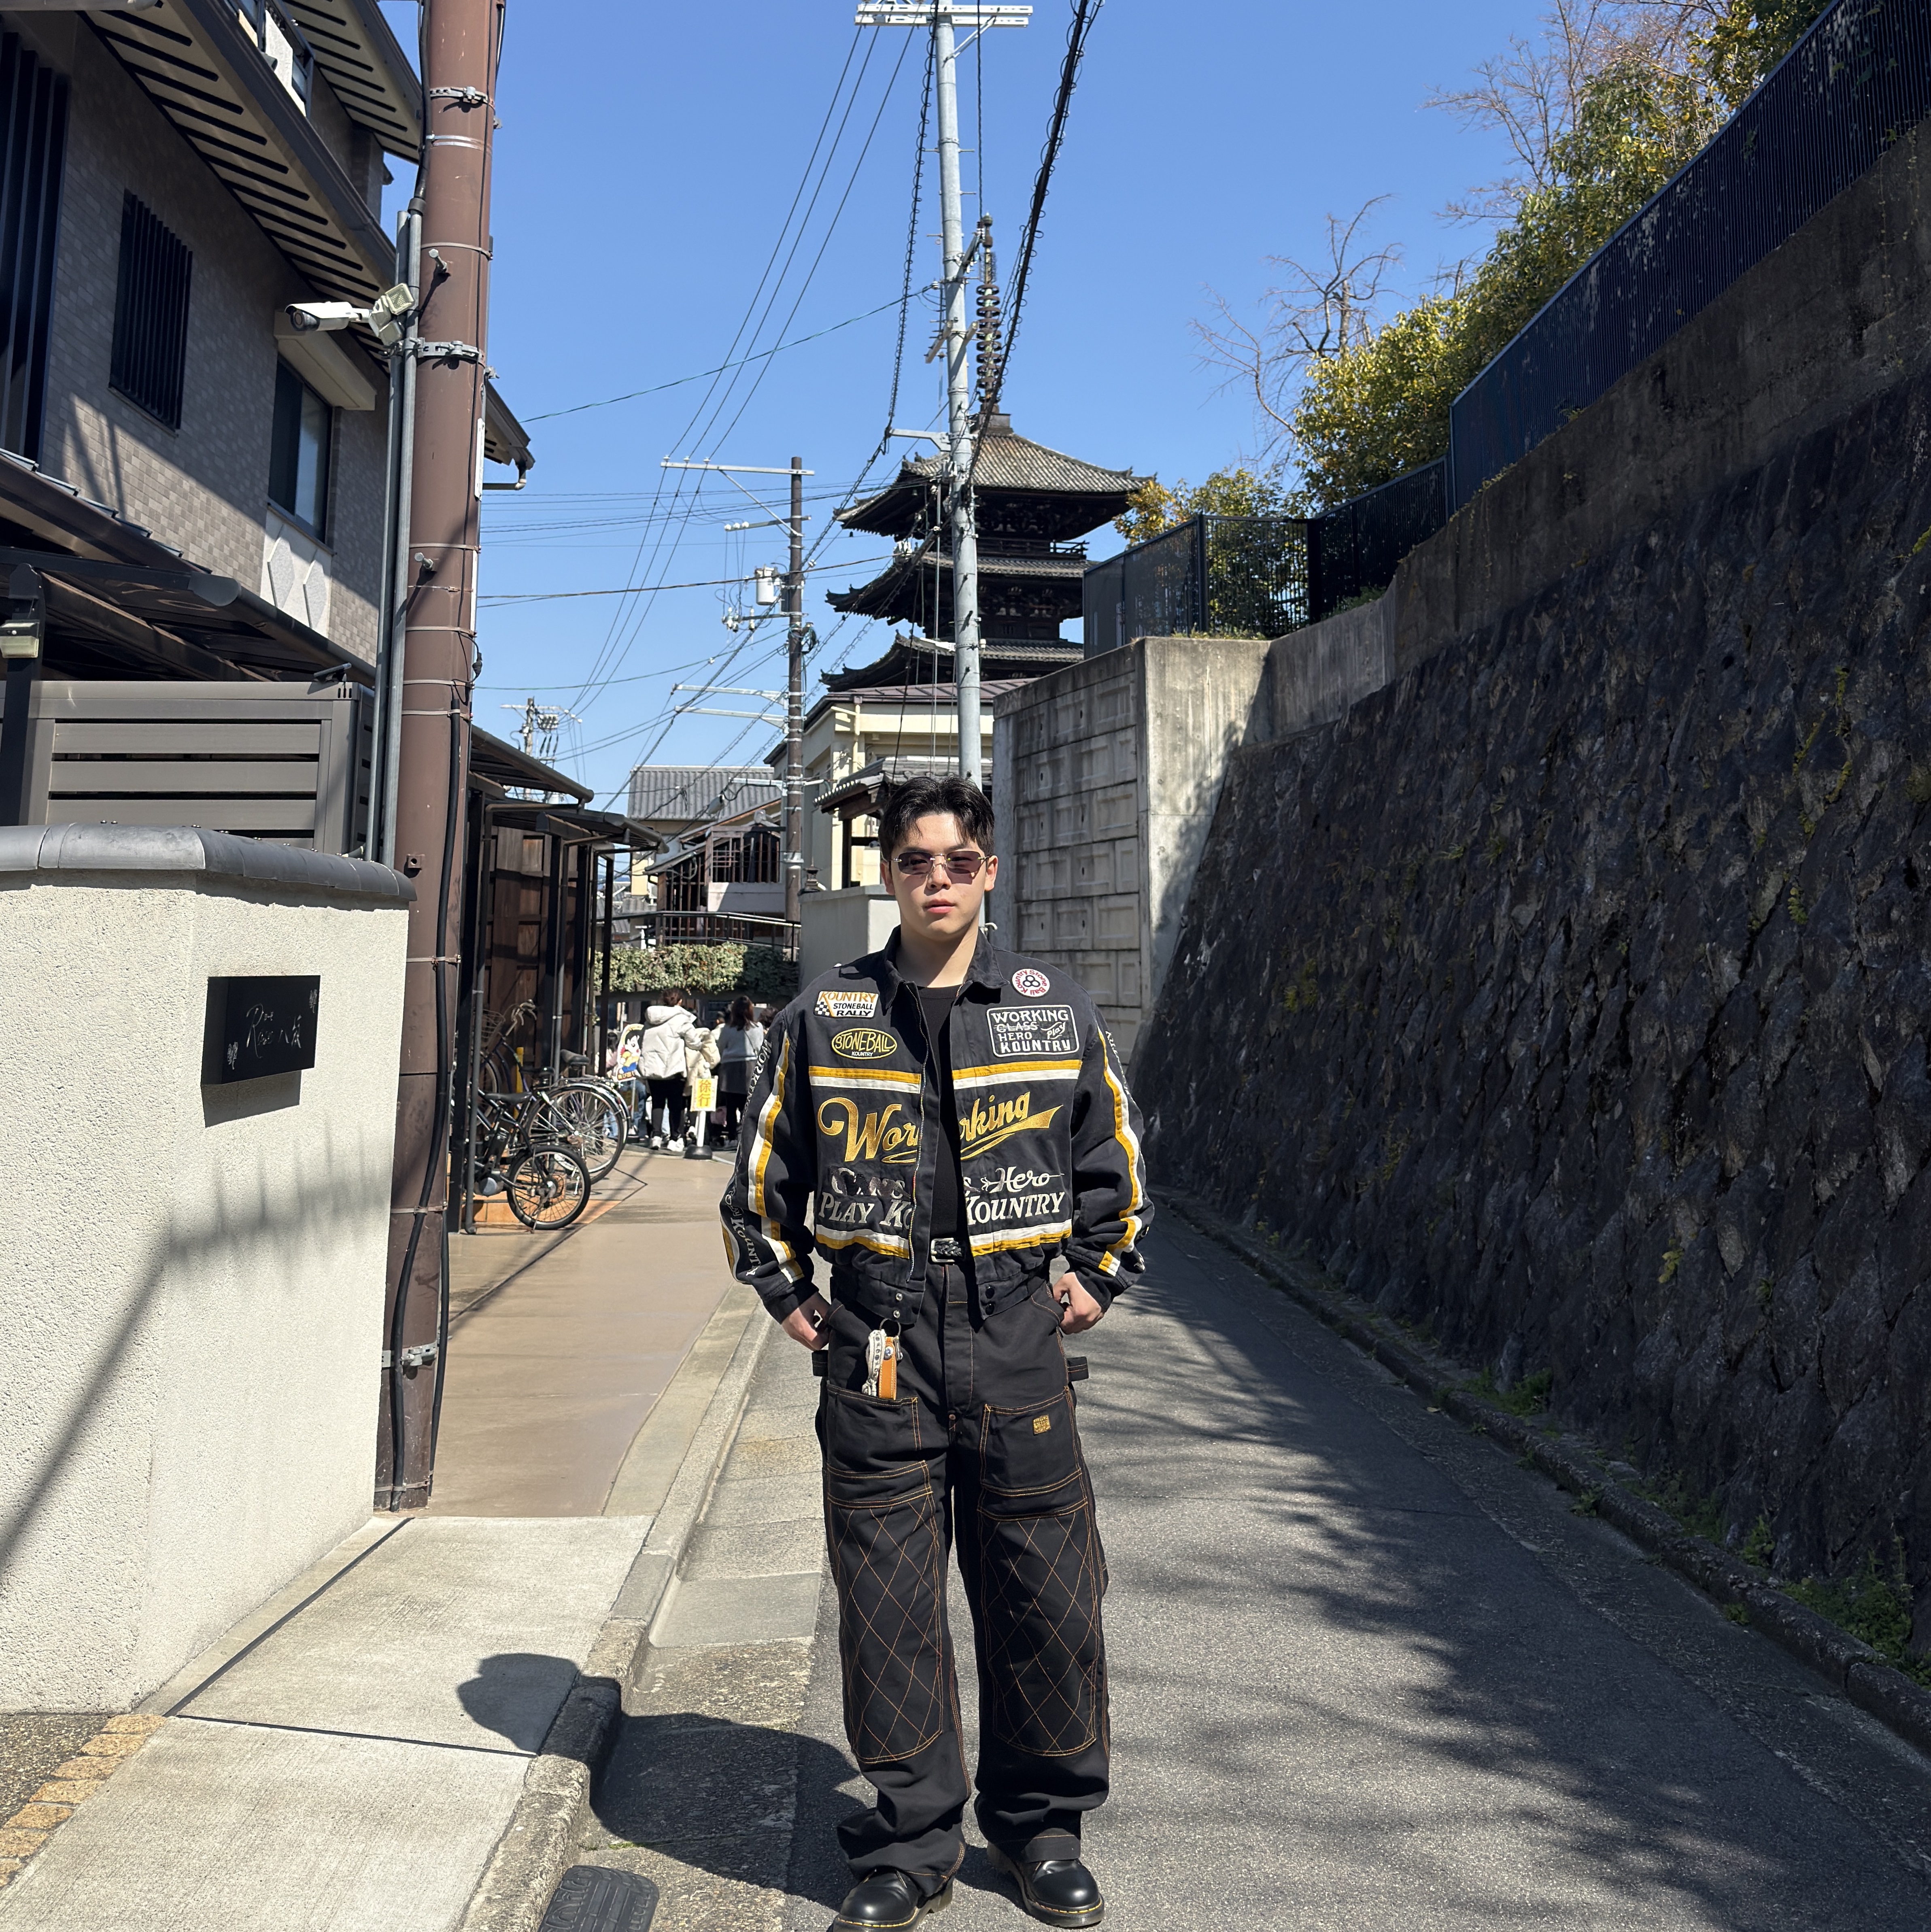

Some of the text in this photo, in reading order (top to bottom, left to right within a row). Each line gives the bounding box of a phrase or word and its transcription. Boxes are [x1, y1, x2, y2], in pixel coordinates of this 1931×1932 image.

[1015, 970, 1047, 995] Kountry Stone Ball
[991, 1010, 1069, 1023] WORKING
[996, 1021, 1038, 1033] CLASS
[835, 1031, 895, 1052] STONEBALL
[998, 1032, 1032, 1041] HERO
[1001, 1039, 1071, 1053] KOUNTRY
[698, 1080, 711, 1106] 徐行
[989, 1166, 1050, 1194] Hero
[818, 1191, 875, 1224] PLAY
